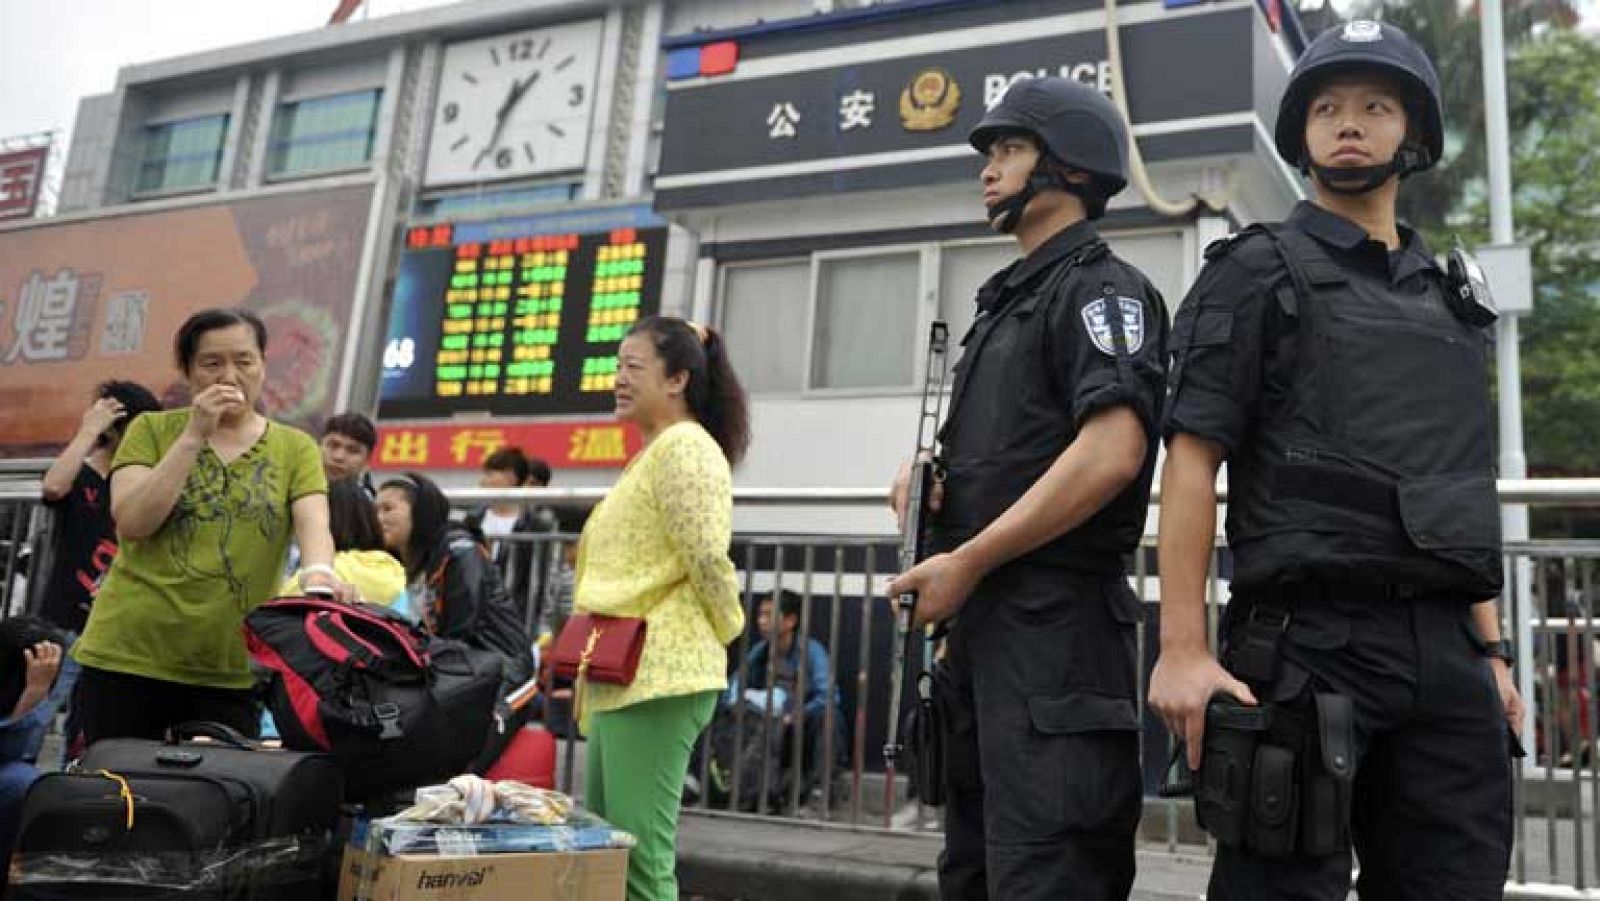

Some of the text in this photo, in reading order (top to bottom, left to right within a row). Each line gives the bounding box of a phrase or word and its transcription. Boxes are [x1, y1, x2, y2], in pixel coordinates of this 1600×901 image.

[508, 39, 534, 62] 12
[567, 83, 585, 107] 3
[443, 101, 460, 124] 9
[495, 148, 513, 169] 6
